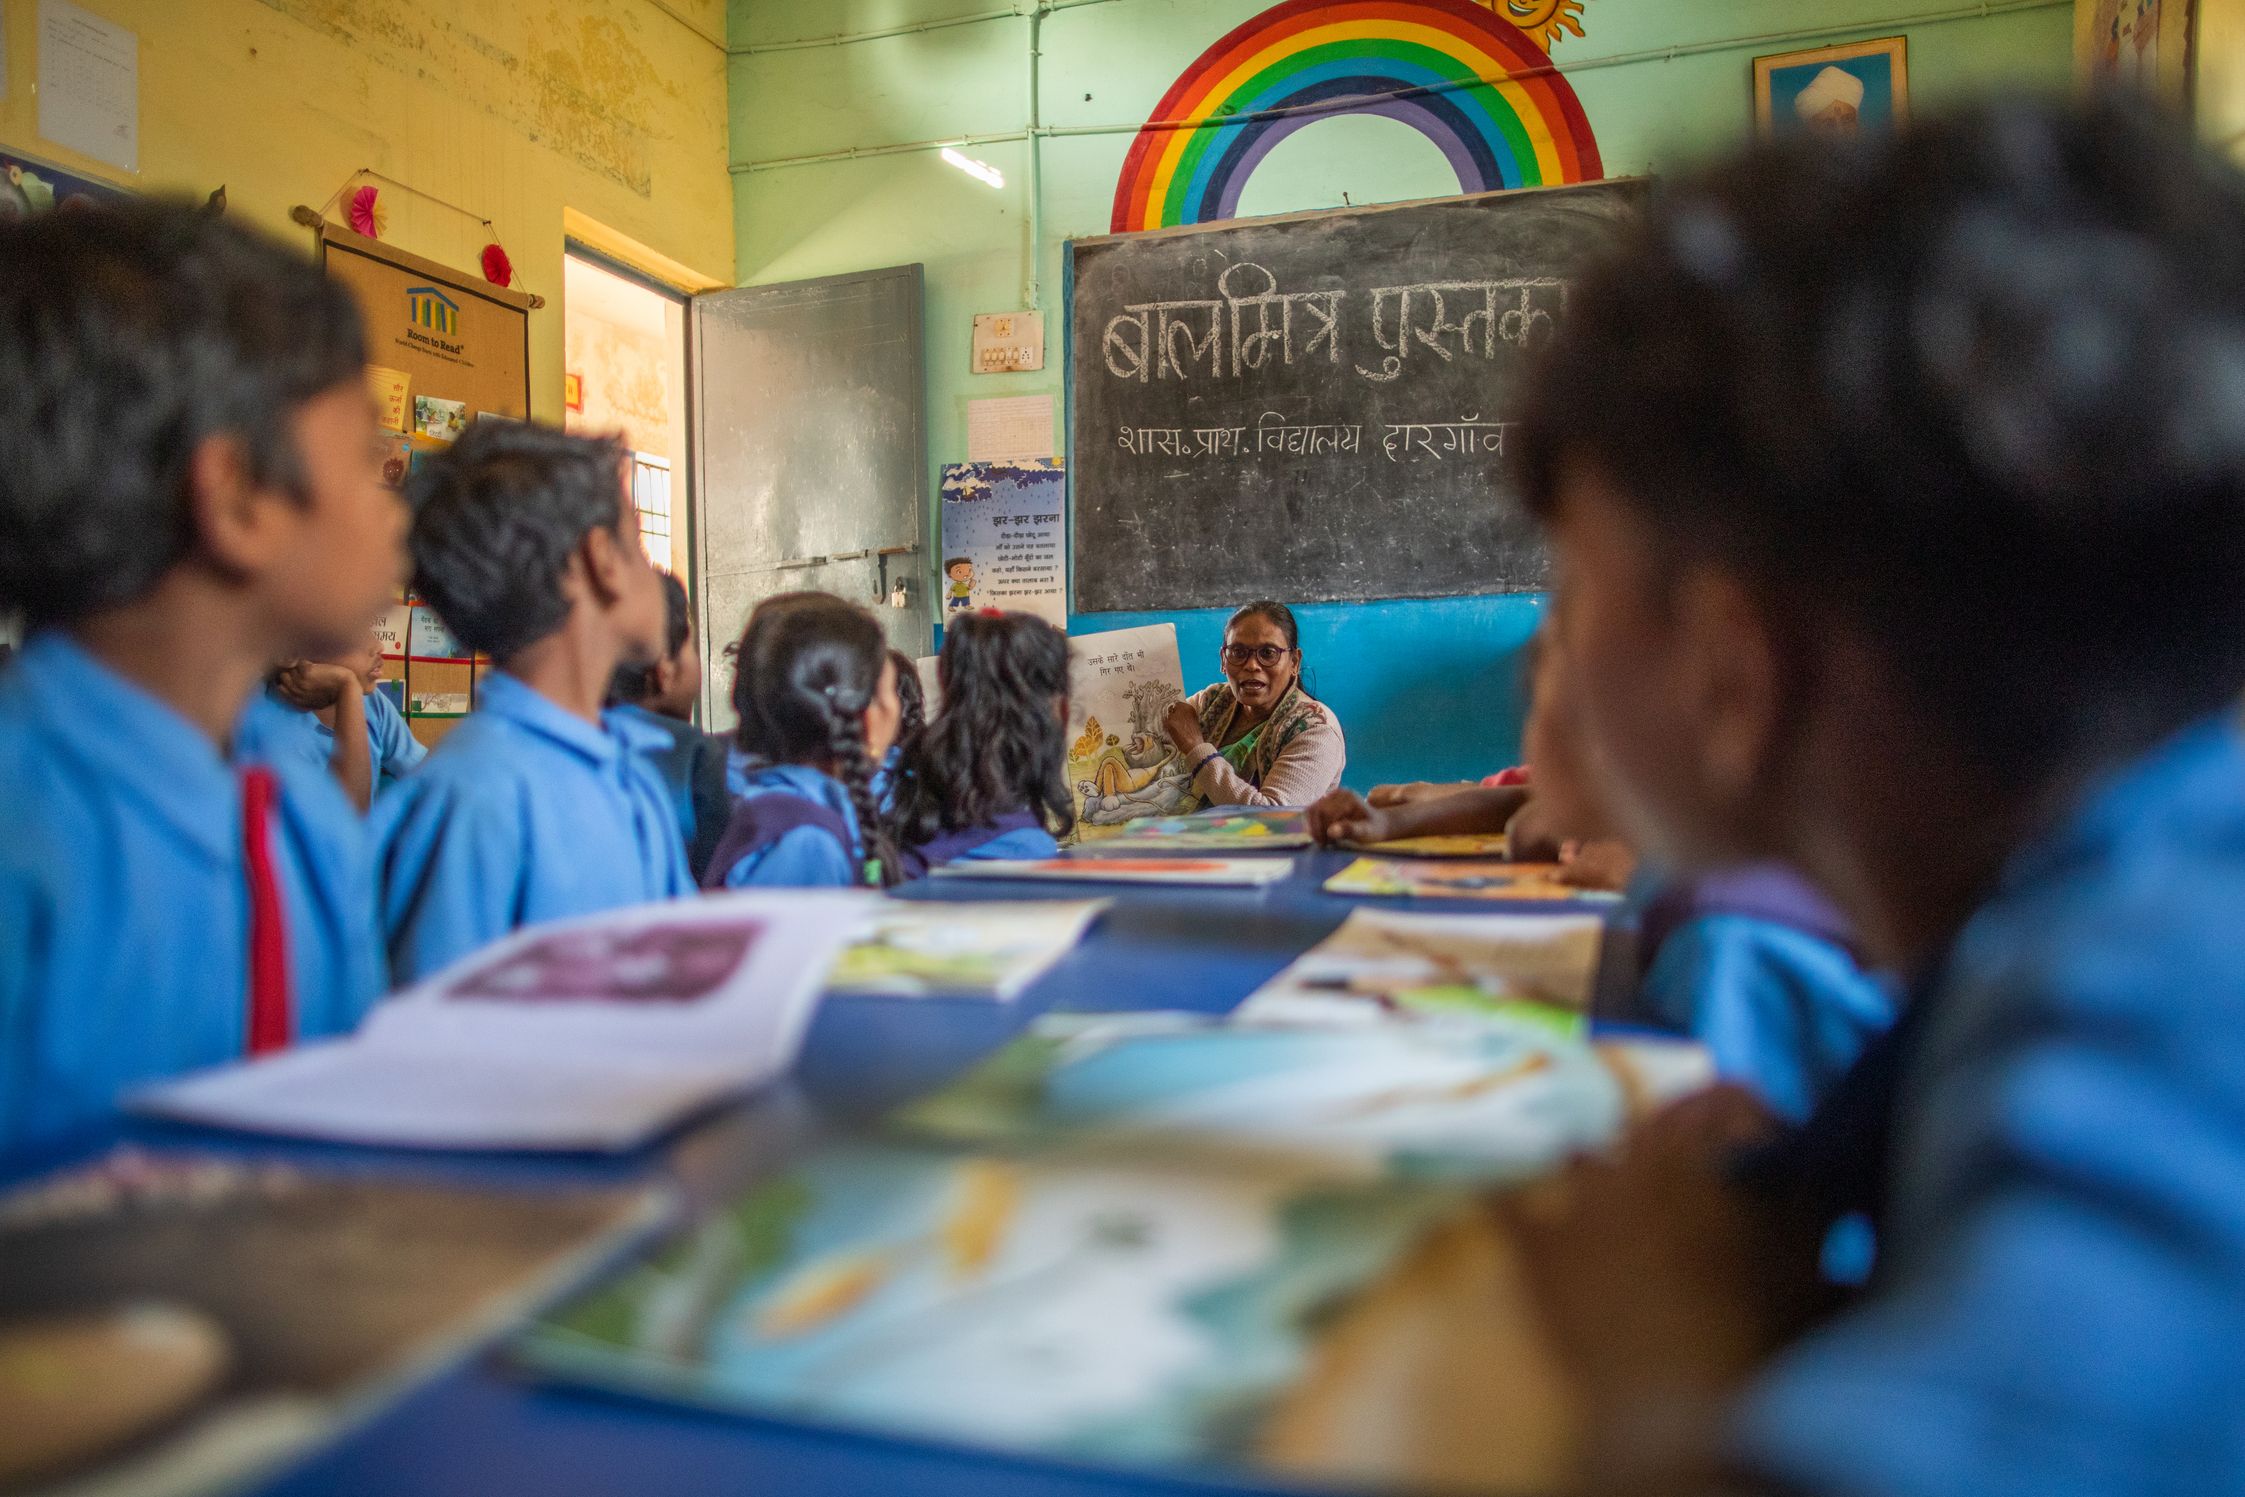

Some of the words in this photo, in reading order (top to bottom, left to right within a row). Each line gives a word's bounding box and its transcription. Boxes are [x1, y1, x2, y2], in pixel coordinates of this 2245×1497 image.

[1102, 262, 1346, 383] बालमित्र
[407, 328, 430, 345] Room
[431, 337, 439, 349] to
[1252, 411, 1363, 456] विद्यालय
[992, 514, 1030, 528] झर-झर
[1033, 513, 1060, 525] झरना
[1088, 655, 1104, 666] उसके
[1107, 653, 1118, 663] सारे
[1136, 649, 1145, 659] भी
[1100, 666, 1111, 676] गिर
[1114, 666, 1124, 674] गए
